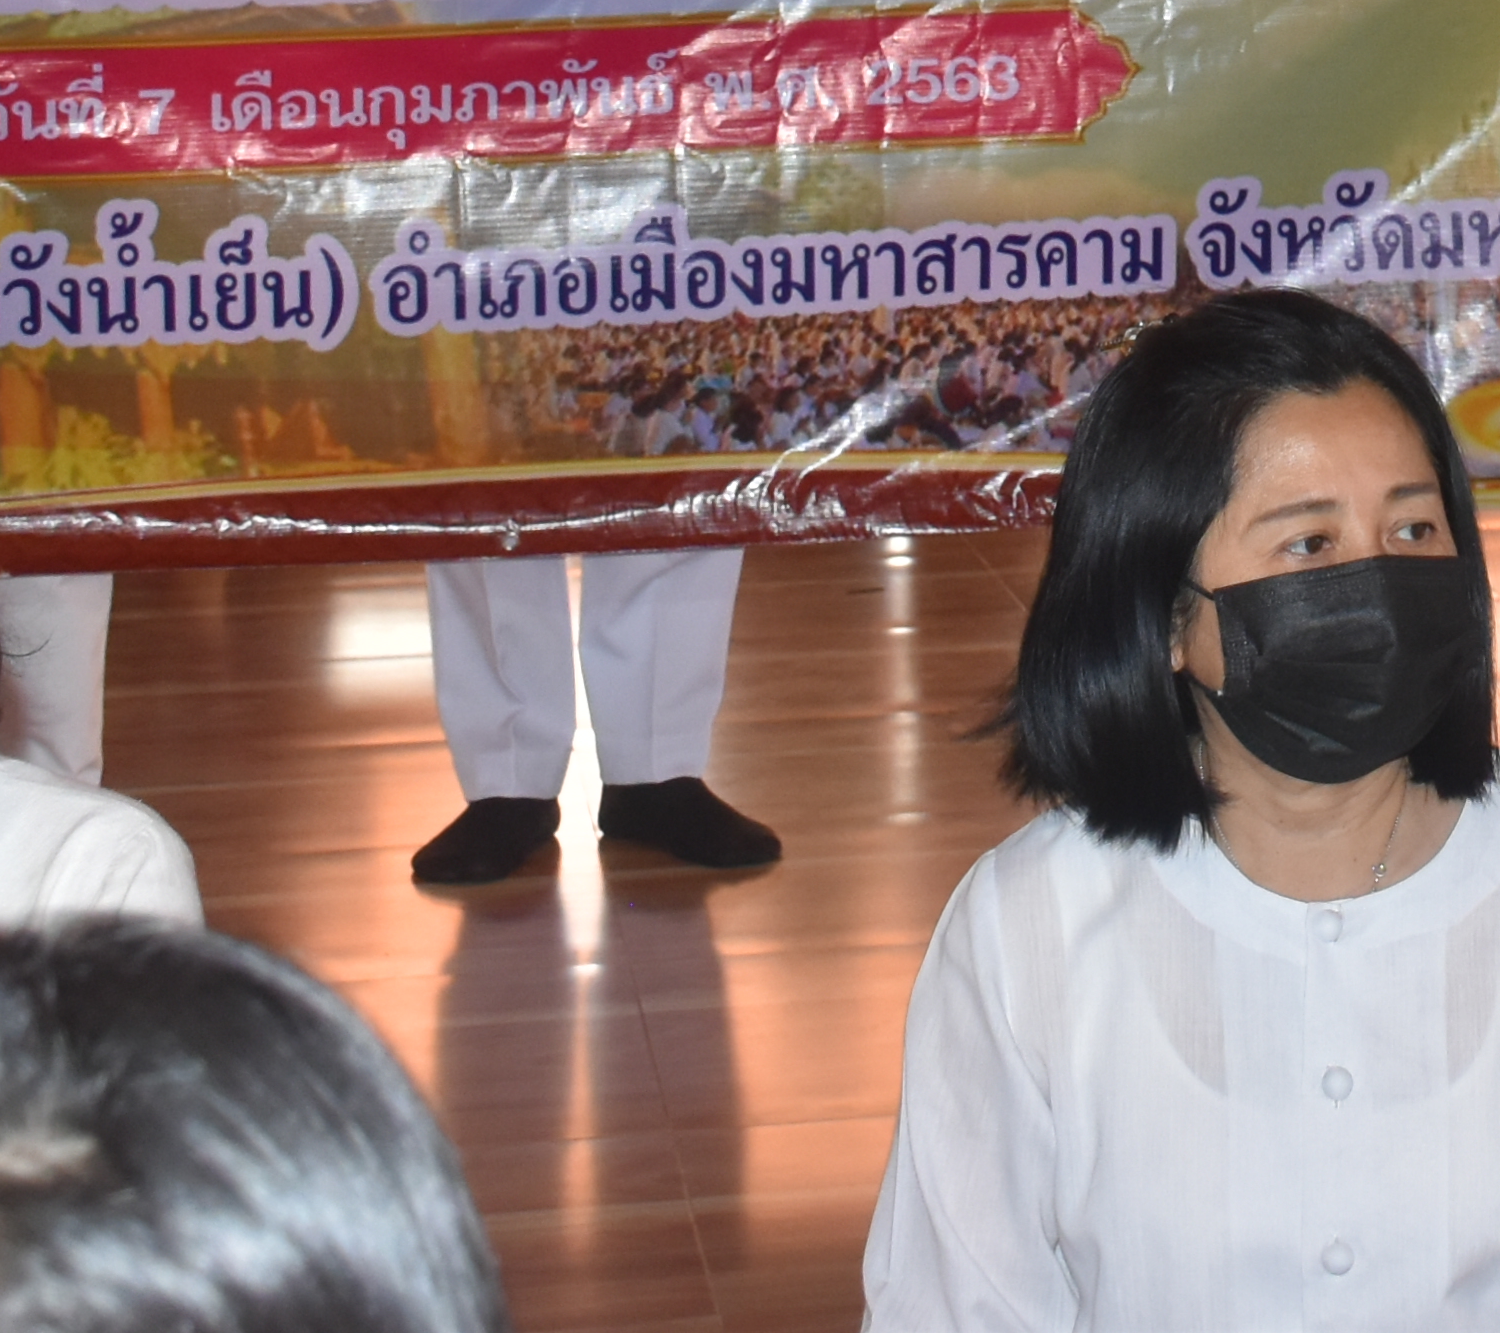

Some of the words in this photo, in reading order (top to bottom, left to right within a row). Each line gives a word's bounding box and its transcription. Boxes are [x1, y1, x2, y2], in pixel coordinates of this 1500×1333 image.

[138, 89, 176, 135] 7
[211, 49, 680, 150] เดือนกุมภาพันธ์
[866, 55, 1021, 107] 2563
[387, 215, 1164, 323] อำเภอเมืองมหาสารคาม
